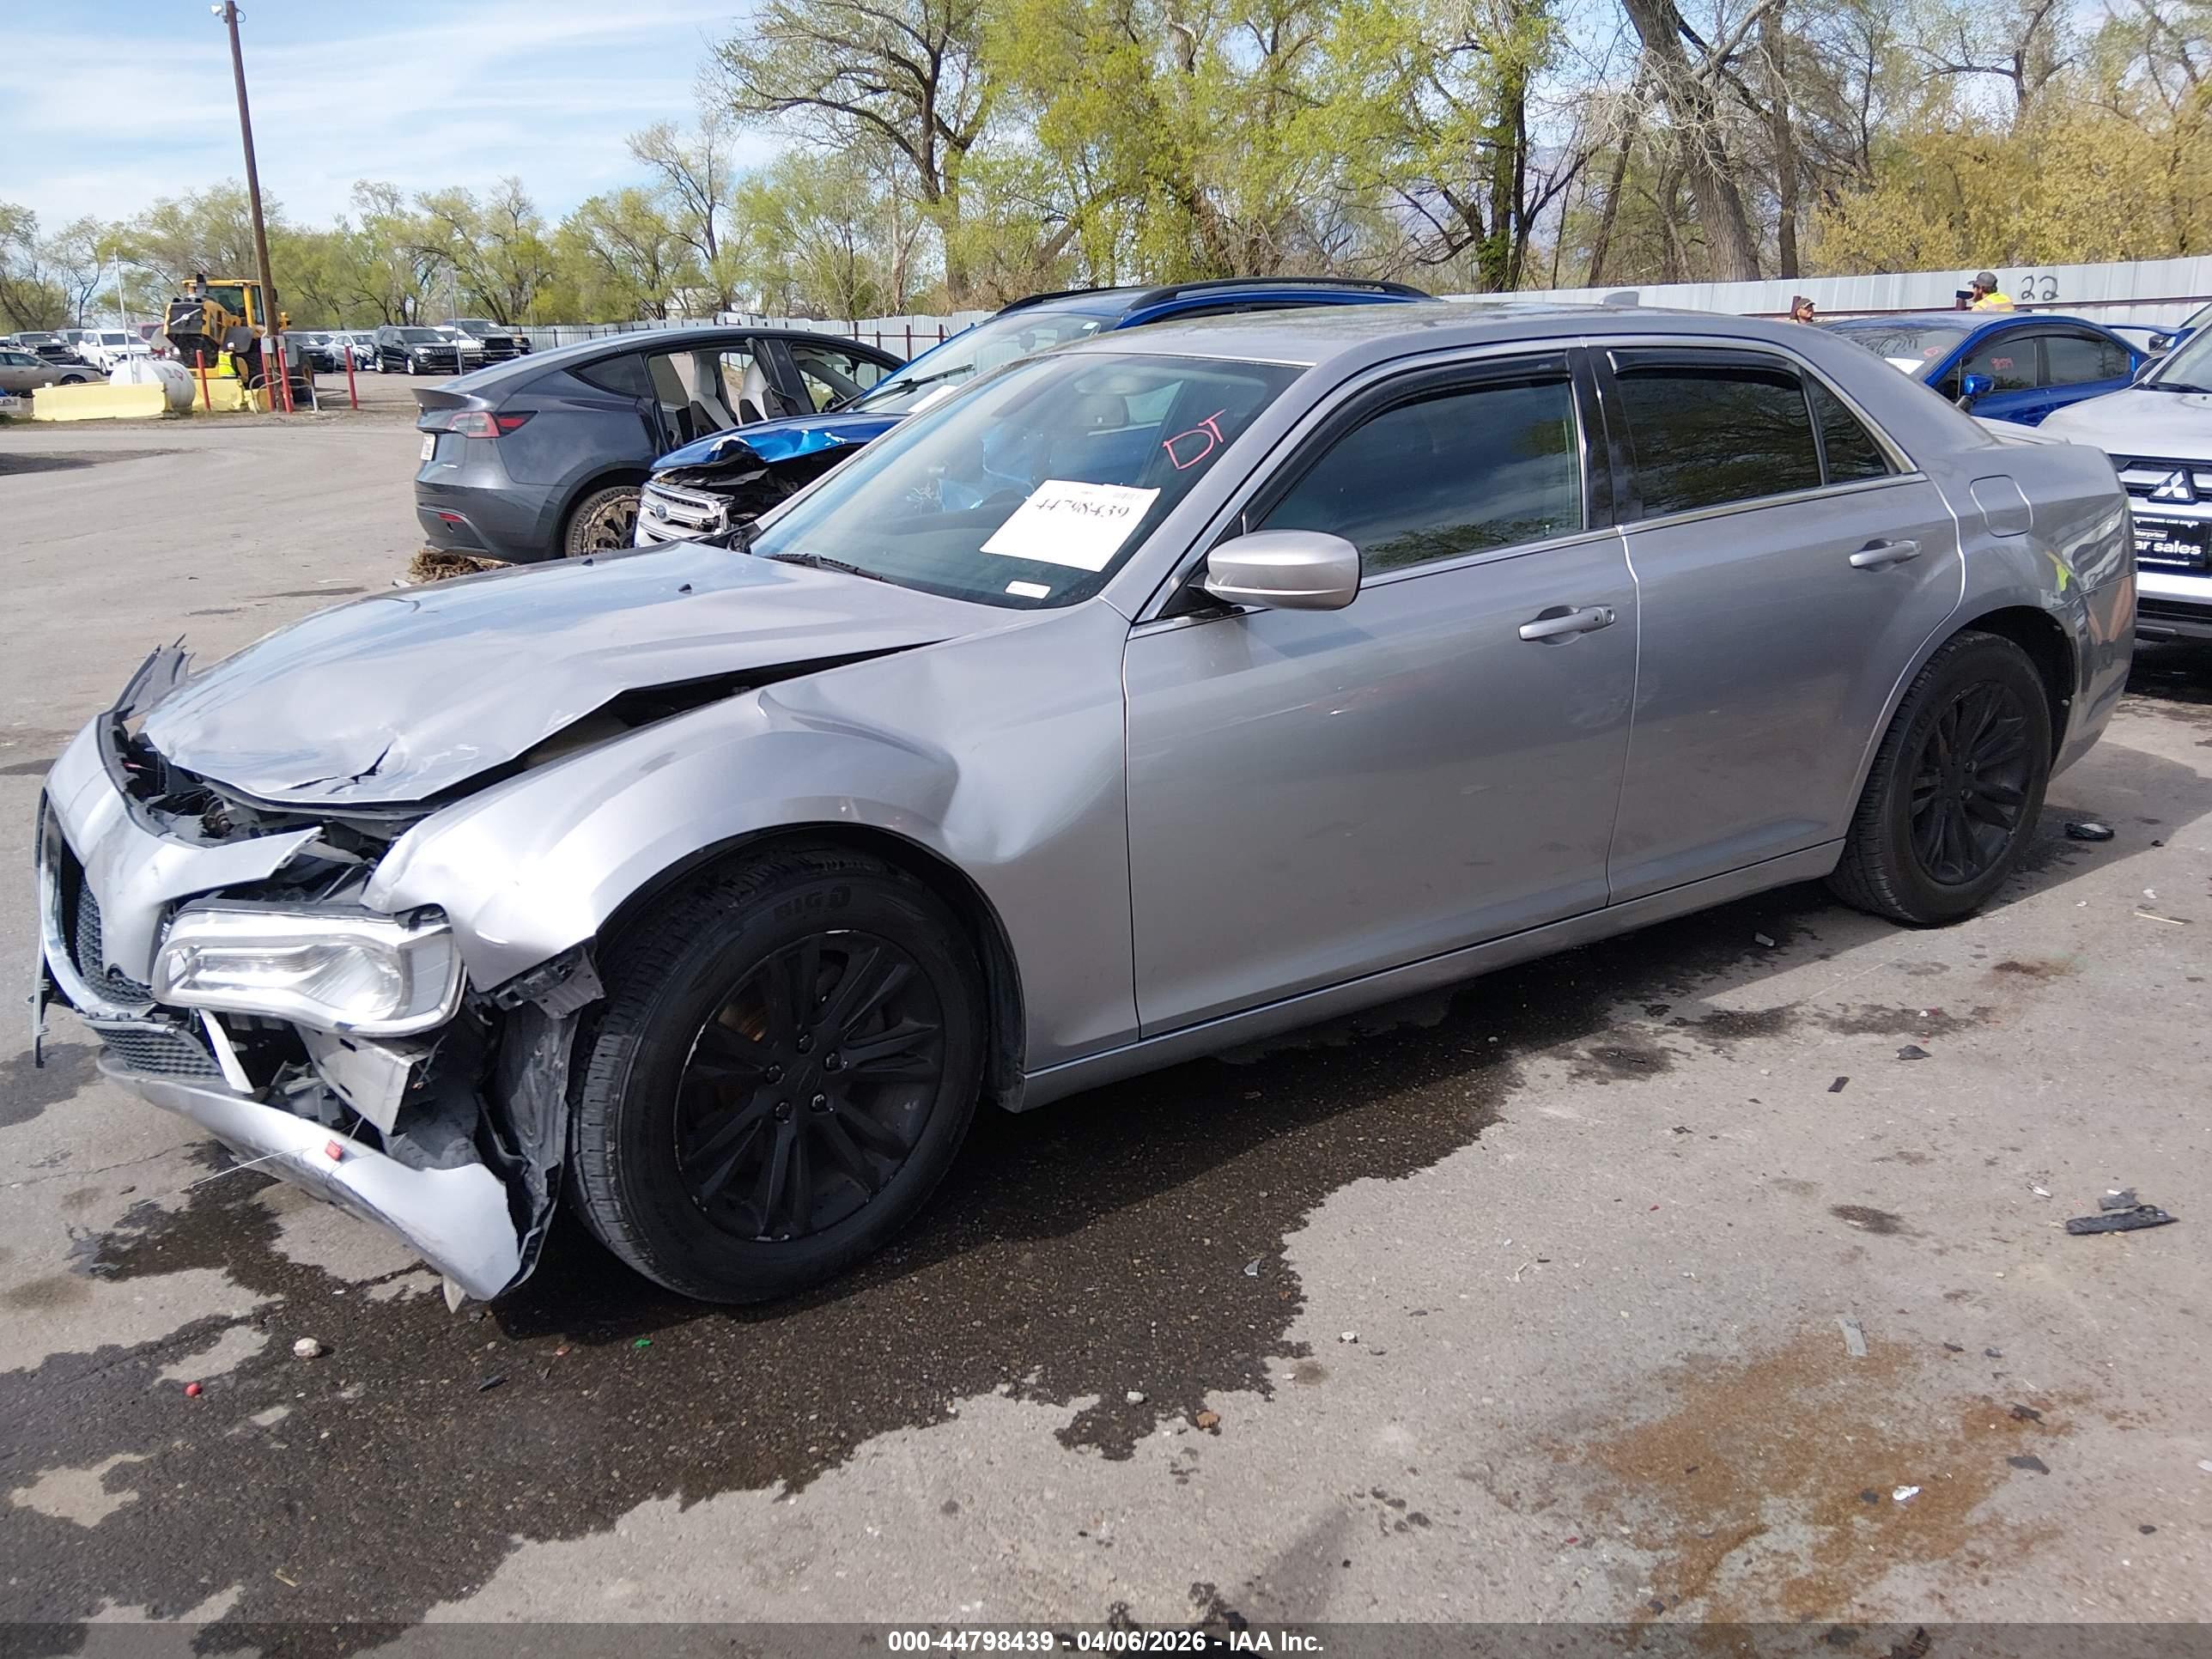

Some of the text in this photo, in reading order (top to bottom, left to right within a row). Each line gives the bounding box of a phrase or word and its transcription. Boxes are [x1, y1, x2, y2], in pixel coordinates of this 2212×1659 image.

[2021, 275, 2059, 301] 22
[1162, 408, 1227, 470] DT
[2134, 539, 2202, 556] ar sales
